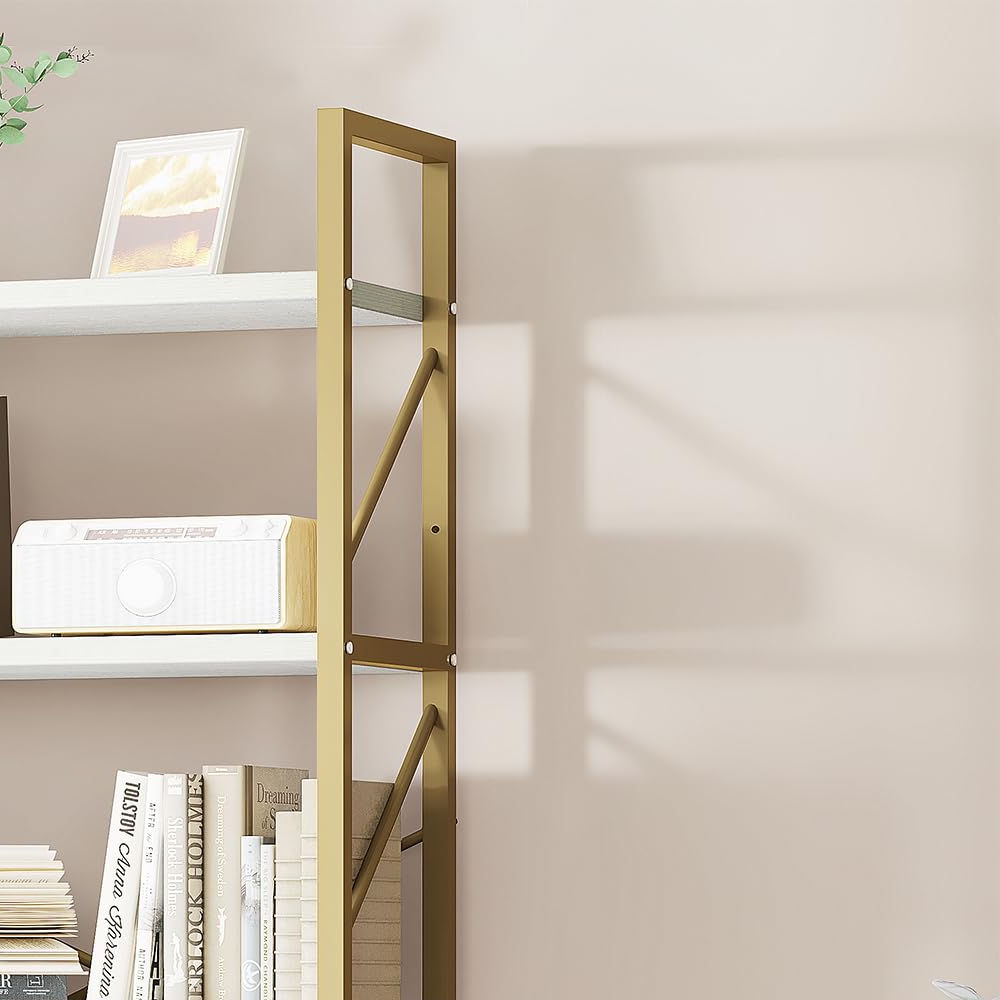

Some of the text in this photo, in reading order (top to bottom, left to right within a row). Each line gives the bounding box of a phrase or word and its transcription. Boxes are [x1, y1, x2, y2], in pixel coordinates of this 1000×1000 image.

[257, 782, 300, 805] Dreaming
[187, 773, 203, 880] HOLMES
[216, 795, 226, 846] Dreaming
[261, 815, 269, 830] of
[99, 782, 142, 998] TOLSTOY Anna Karenina
[167, 817, 184, 917] Sherlock Holmes
[217, 859, 226, 898] Sweden
